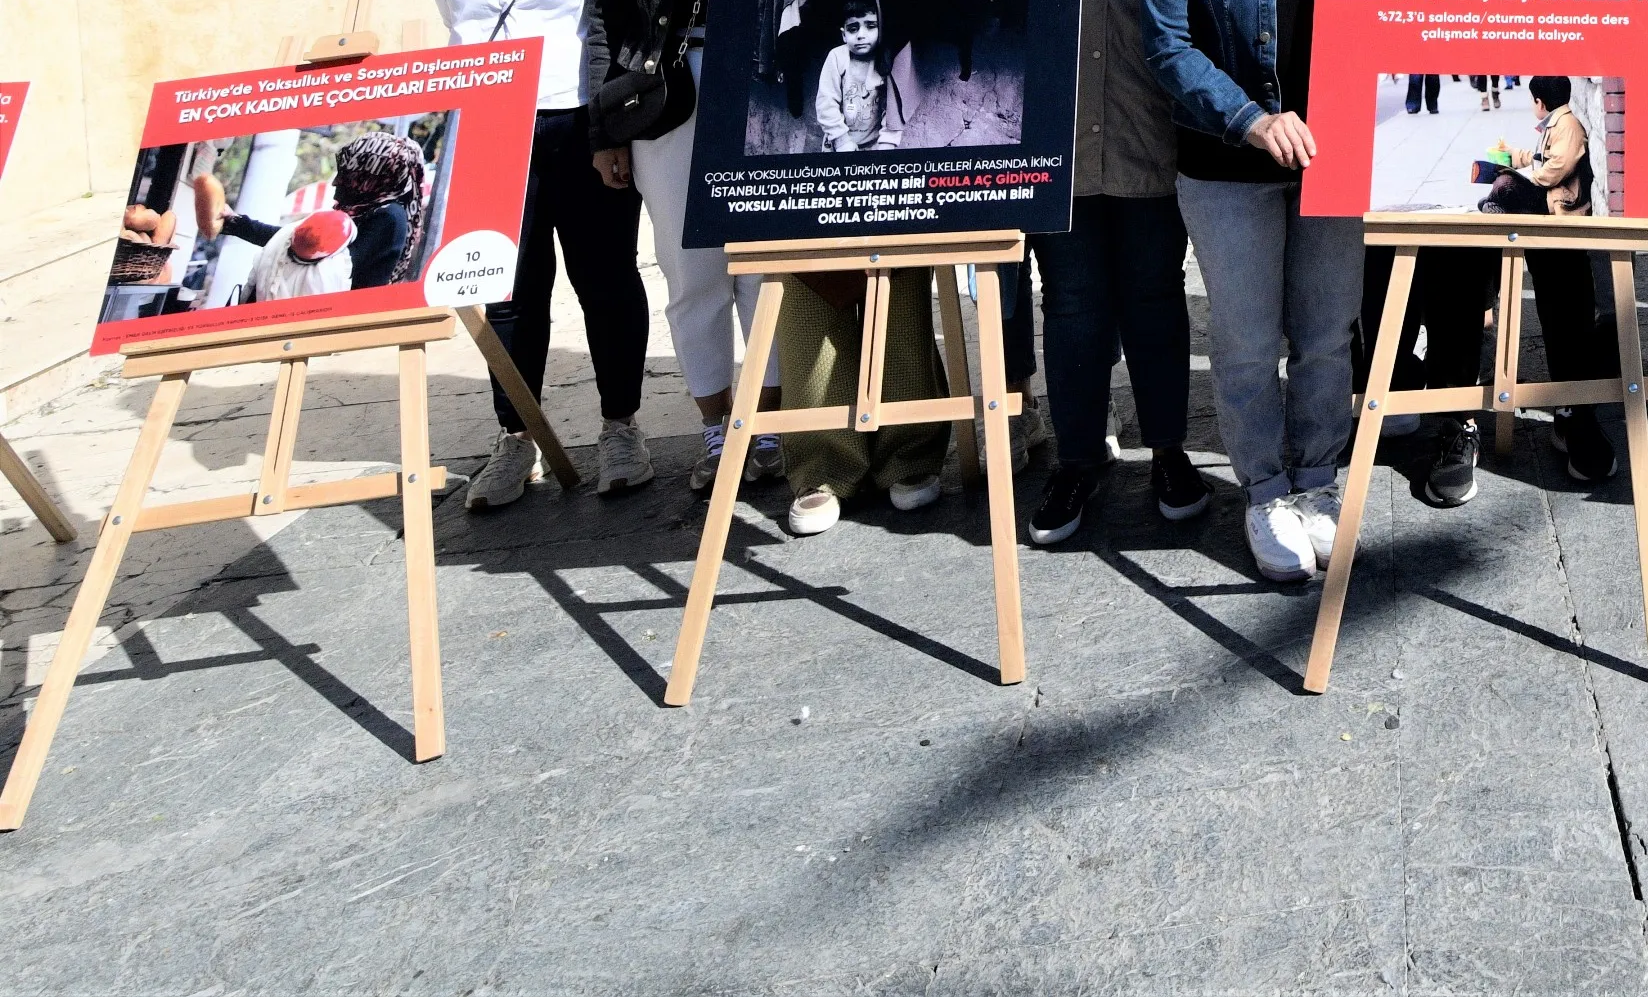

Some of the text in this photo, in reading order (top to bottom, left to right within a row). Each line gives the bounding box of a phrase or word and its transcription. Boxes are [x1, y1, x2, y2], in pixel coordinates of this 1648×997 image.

[1428, 11, 1534, 24] salonda/oturma
[1537, 13, 1598, 25] odasında
[1601, 13, 1630, 25] ders
[1421, 27, 1584, 43] çalışmak zorunda kalıyor.
[175, 49, 525, 103] Türkiye'de Yoksulluk ve Sosyal Dışlanma Riski
[178, 69, 514, 124] EN ÇOK KADIN VE ÇOCUKLARI ETKİLİYOR!
[704, 155, 1062, 184] ÇOCUK YOKSULLUĞUNDA TÜRKİYE OECD ÜLKELERİ ARASINDA İKİNCİ
[711, 170, 1053, 198] İSTANBUL'DA HER 4 ÇOCUKTAN BİRİ OKULA AÇ GİDİYOR.
[728, 186, 1034, 213] YOKSUL AİLELERDE YETİŞEN HER 3 ÇOCUKTAN BİRİ
[818, 207, 939, 224] OKULA GİDEMİYOR.
[466, 251, 481, 262] 10
[436, 266, 504, 282] Kadından
[457, 284, 478, 295] 4'ü
